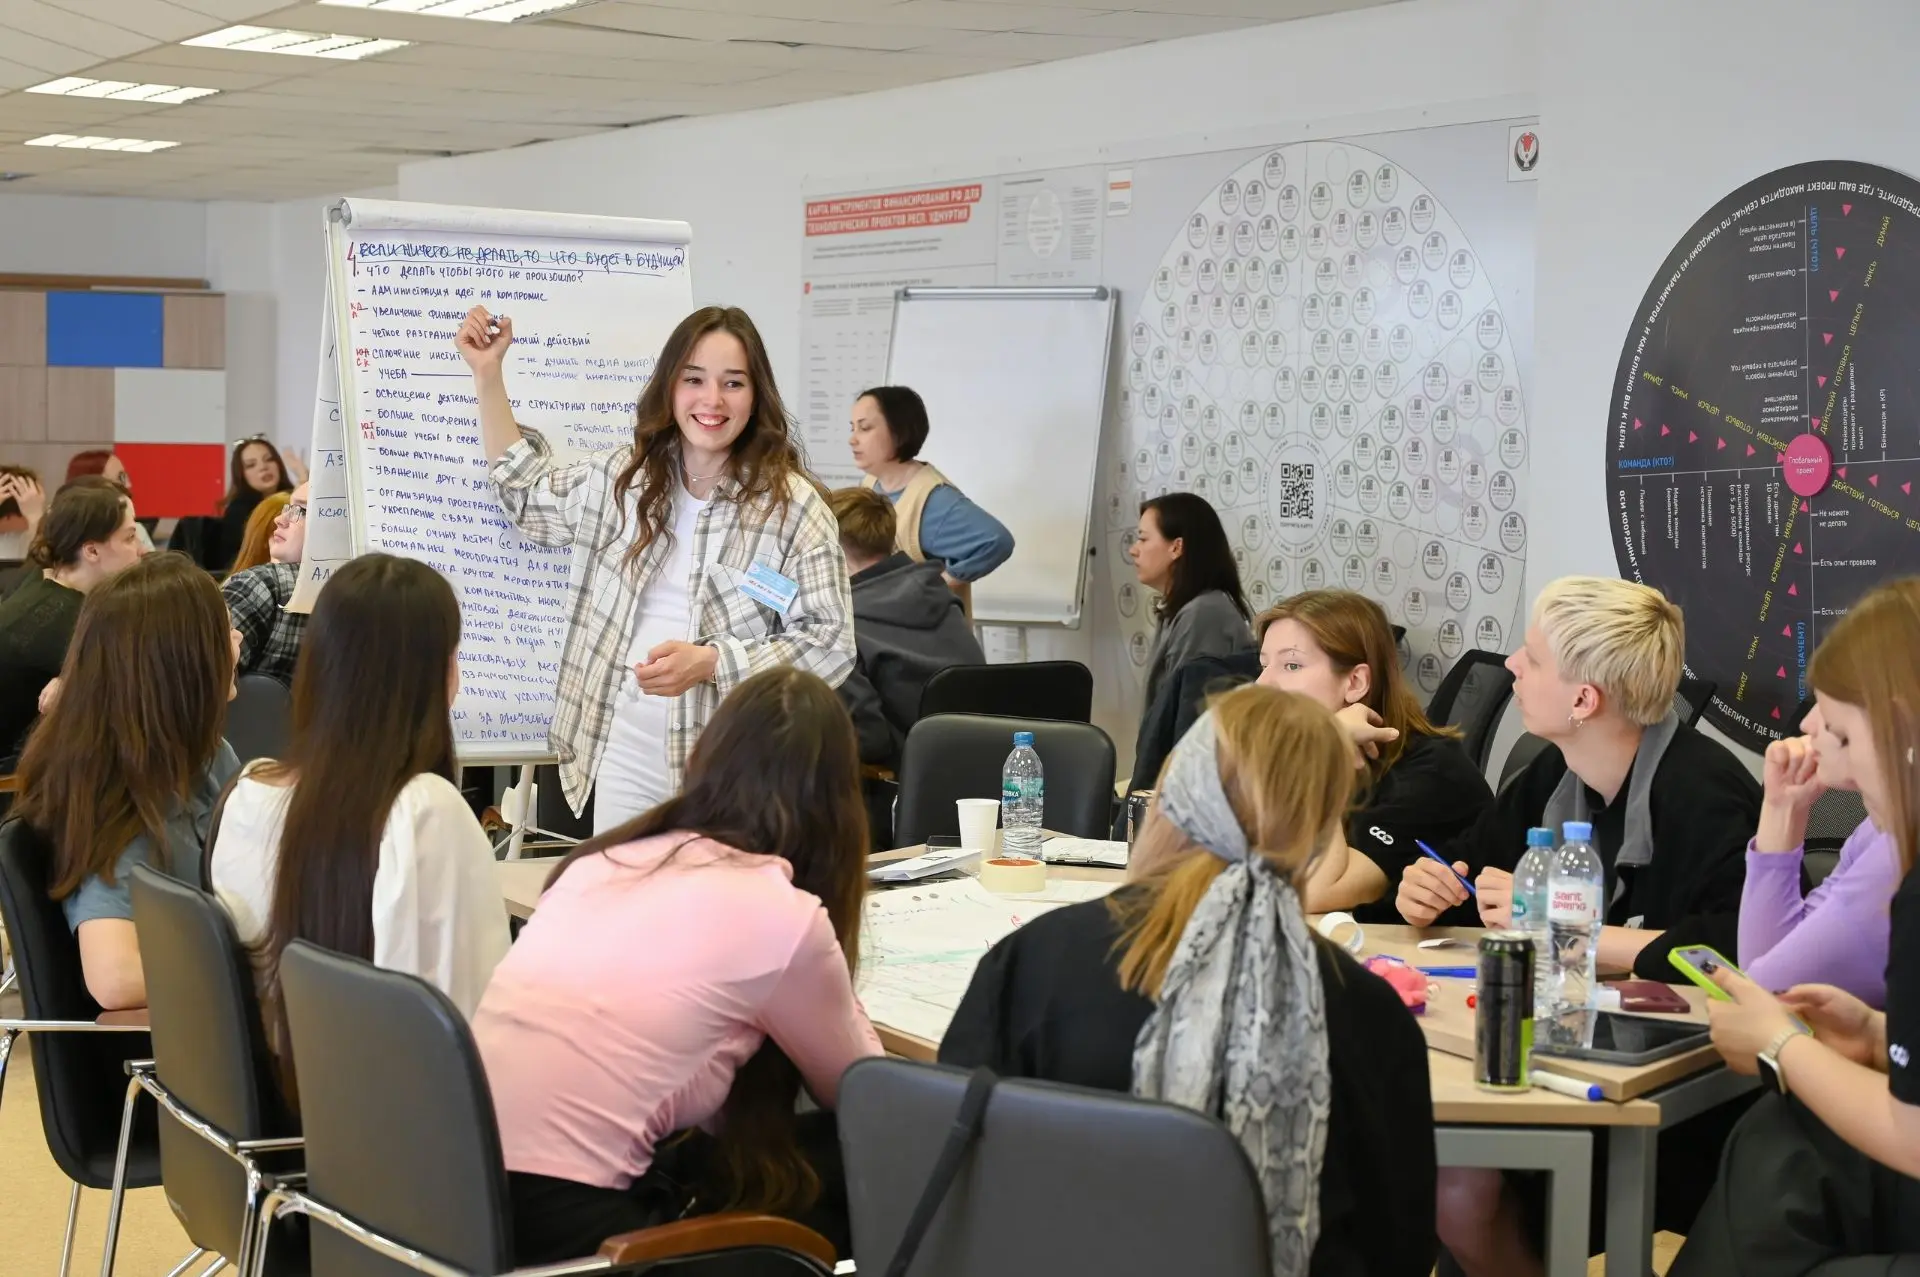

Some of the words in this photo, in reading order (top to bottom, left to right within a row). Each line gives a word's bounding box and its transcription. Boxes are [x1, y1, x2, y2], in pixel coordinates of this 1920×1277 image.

[1760, 184, 1805, 206] НАХОДИТСЯ
[1807, 181, 1837, 192] ПРОЕКТ
[1839, 181, 1857, 191] ВАШ
[1858, 184, 1875, 196] ГДЕ
[1732, 201, 1759, 221] СЕЙЧАС
[1877, 186, 1920, 218] ПРЕДЕЛИТЕ,
[1721, 217, 1731, 229] ПО
[1689, 227, 1720, 262] КАЖДОМУ
[1680, 259, 1689, 272] ИЗ
[1820, 391, 1837, 436] ДЕЙСТВУЙ
[1834, 344, 1851, 386] ГОТОВЬСЯ
[1849, 303, 1864, 336] ЦЕЛЬСЯ
[1864, 261, 1877, 287] УЧИСЬ
[1876, 215, 1891, 247] ДУМАЙ
[1637, 336, 1648, 354] КАК
[1626, 355, 1641, 392] БЛИЗКО
[1623, 394, 1631, 410] ВЫ
[1618, 458, 1651, 469] КОМАНДА
[1653, 455, 1675, 468] (КТО?)
[1619, 490, 1627, 510] ОСИ
[1832, 480, 1865, 501] ДЕЙСТВУЙ
[1868, 498, 1900, 520] ГОТОВЬСЯ
[1621, 511, 1638, 568] КООРДИНАТ
[1771, 543, 1786, 583] ГОТОВЬСЯ
[1711, 694, 1752, 730] ПРЕДЕЛИТЕ,
[1753, 722, 1768, 736] ГДЕ
